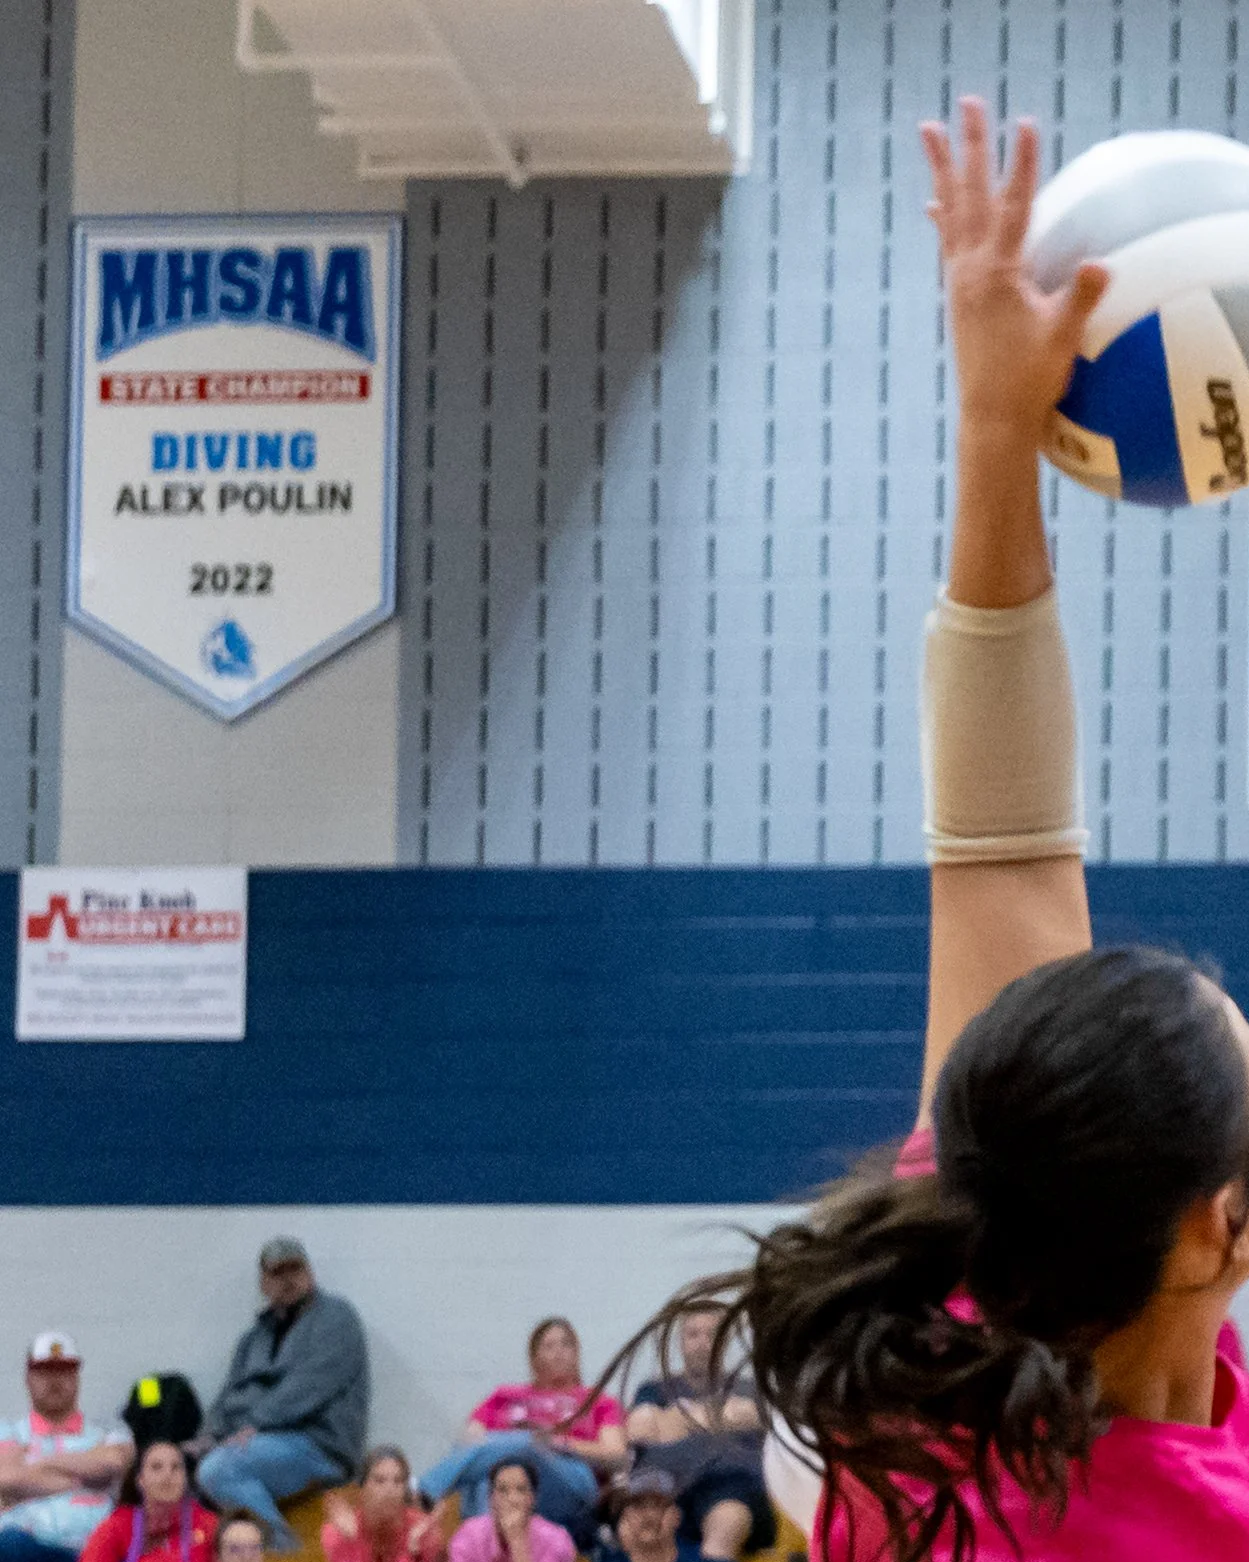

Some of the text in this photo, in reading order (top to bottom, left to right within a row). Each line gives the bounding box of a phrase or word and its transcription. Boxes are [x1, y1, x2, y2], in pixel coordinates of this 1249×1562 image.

[97, 248, 376, 362] MHSAA
[113, 373, 361, 400] STATE CHAMPION
[152, 431, 316, 472] DIVING
[113, 480, 352, 515] ALEX POULIN
[190, 561, 274, 596] 2022
